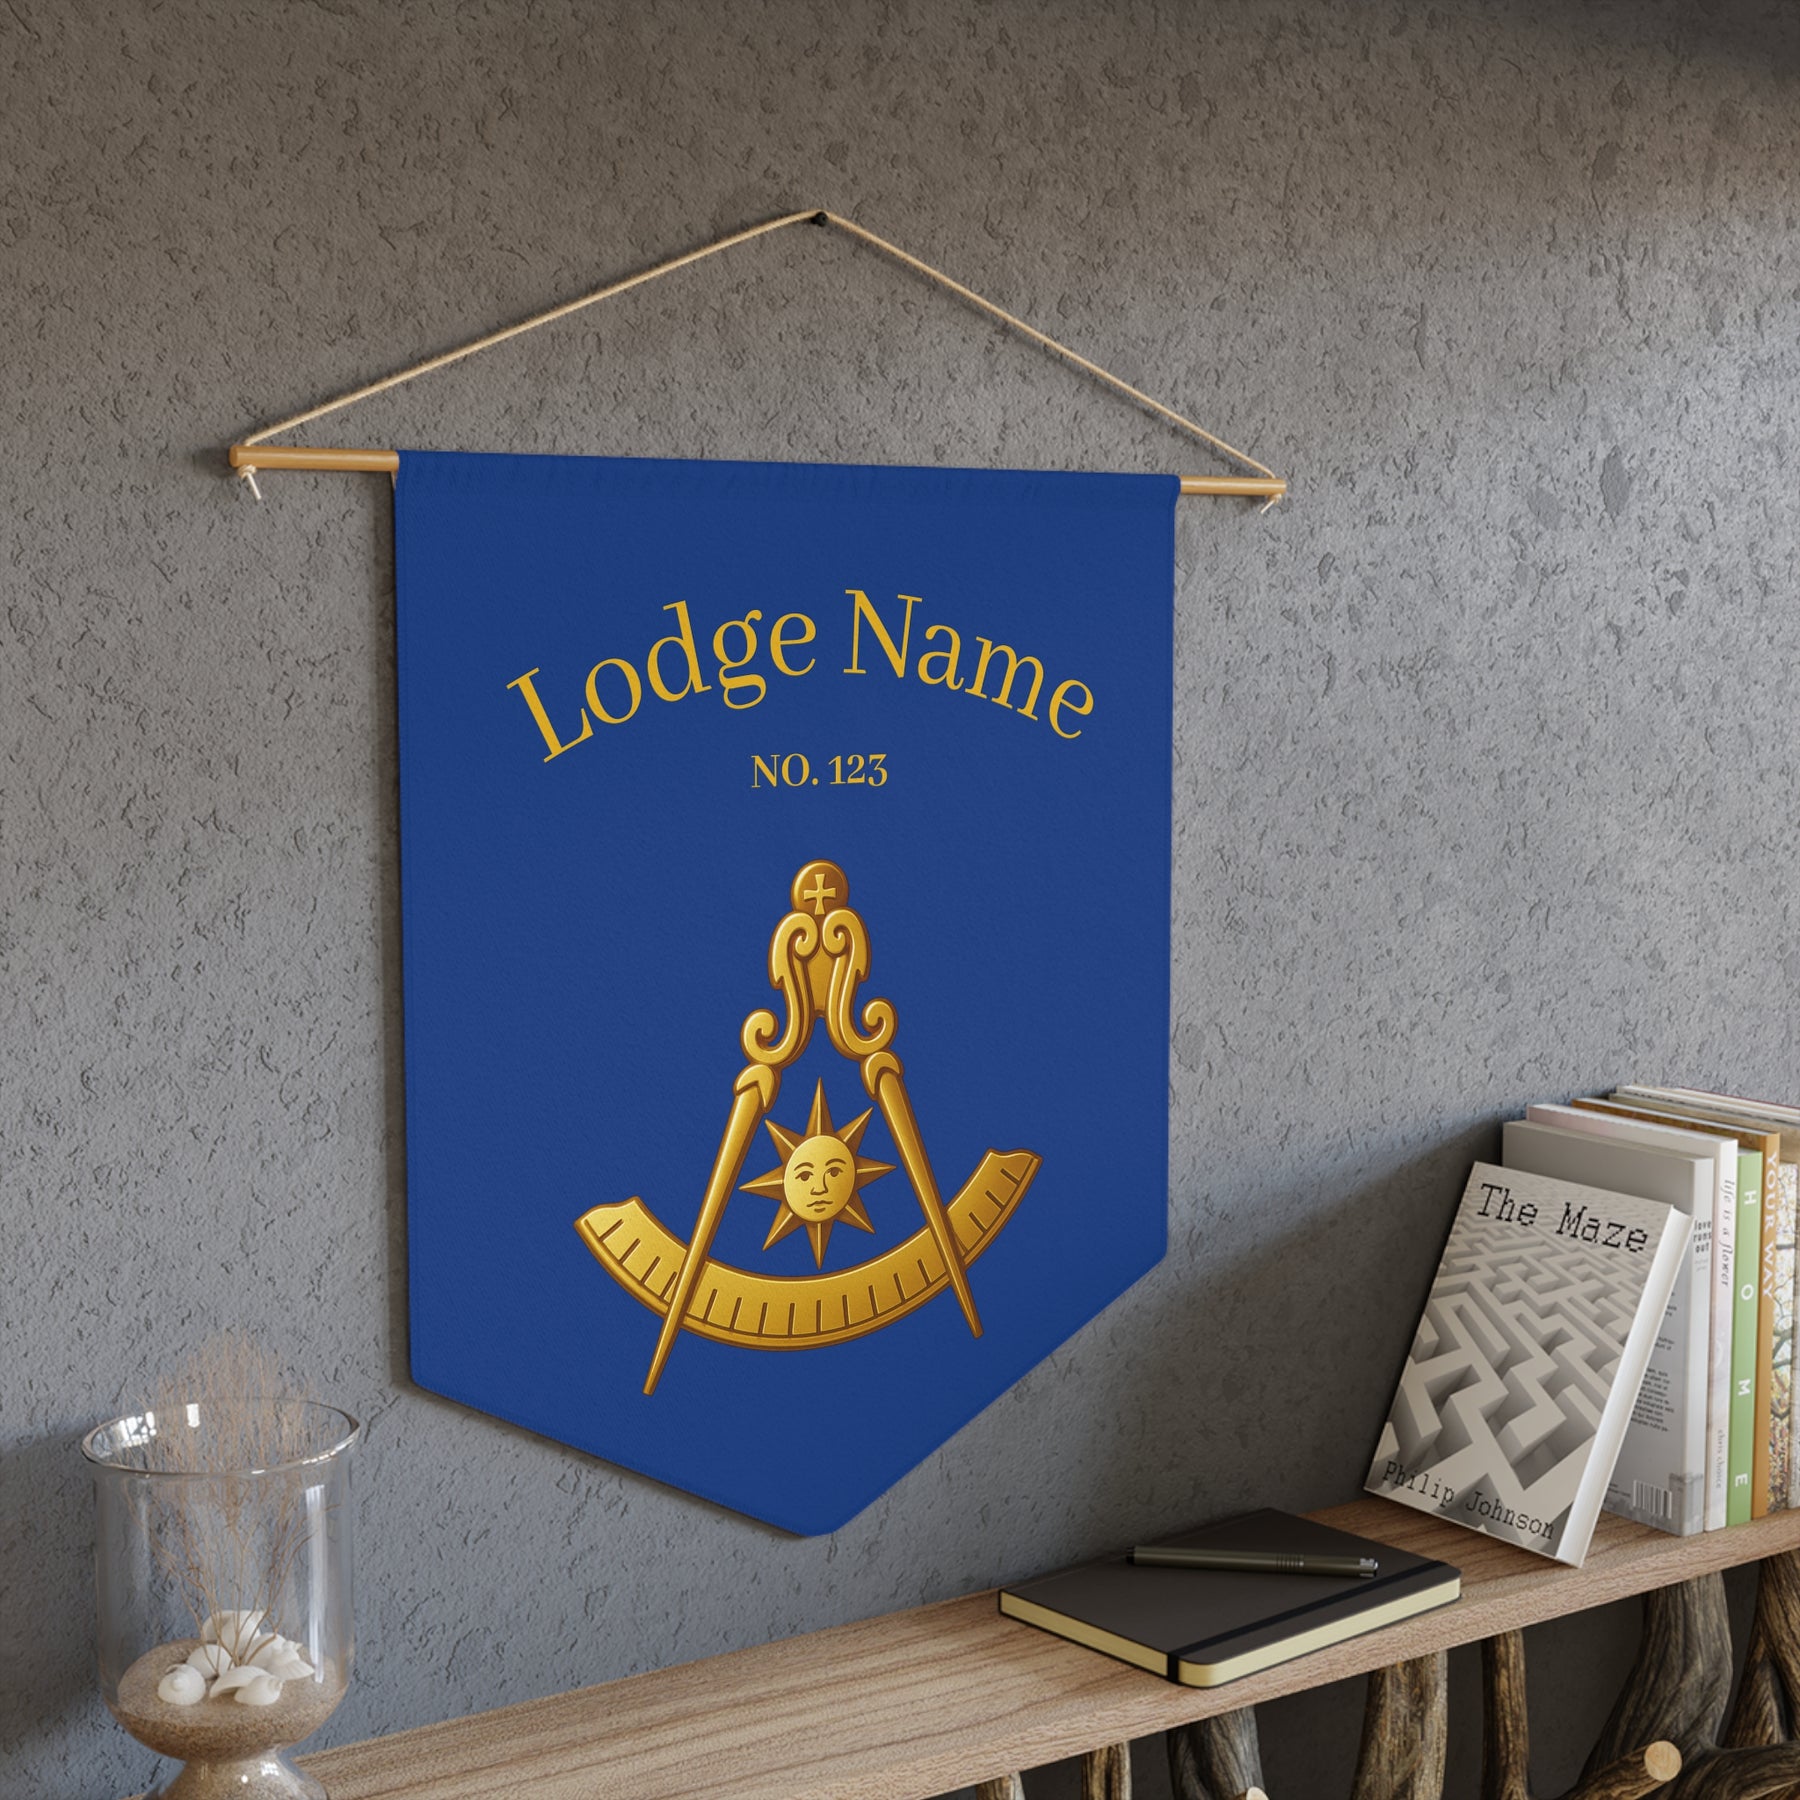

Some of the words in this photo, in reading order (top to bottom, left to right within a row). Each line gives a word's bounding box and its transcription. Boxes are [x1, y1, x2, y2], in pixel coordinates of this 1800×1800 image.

[507, 600, 817, 763] Lodge
[843, 589, 1095, 739] Name
[751, 753, 819, 787] NO.
[828, 753, 888, 786] 123
[1477, 1183, 1538, 1227] The
[1555, 1202, 1649, 1253] Maze
[1722, 1210, 1732, 1221] is
[1764, 1152, 1778, 1232] YOUR
[1719, 1240, 1734, 1287] flower
[1762, 1242, 1775, 1298] WAY
[1382, 1461, 1455, 1508] Philip
[1465, 1491, 1555, 1540] Johnson
